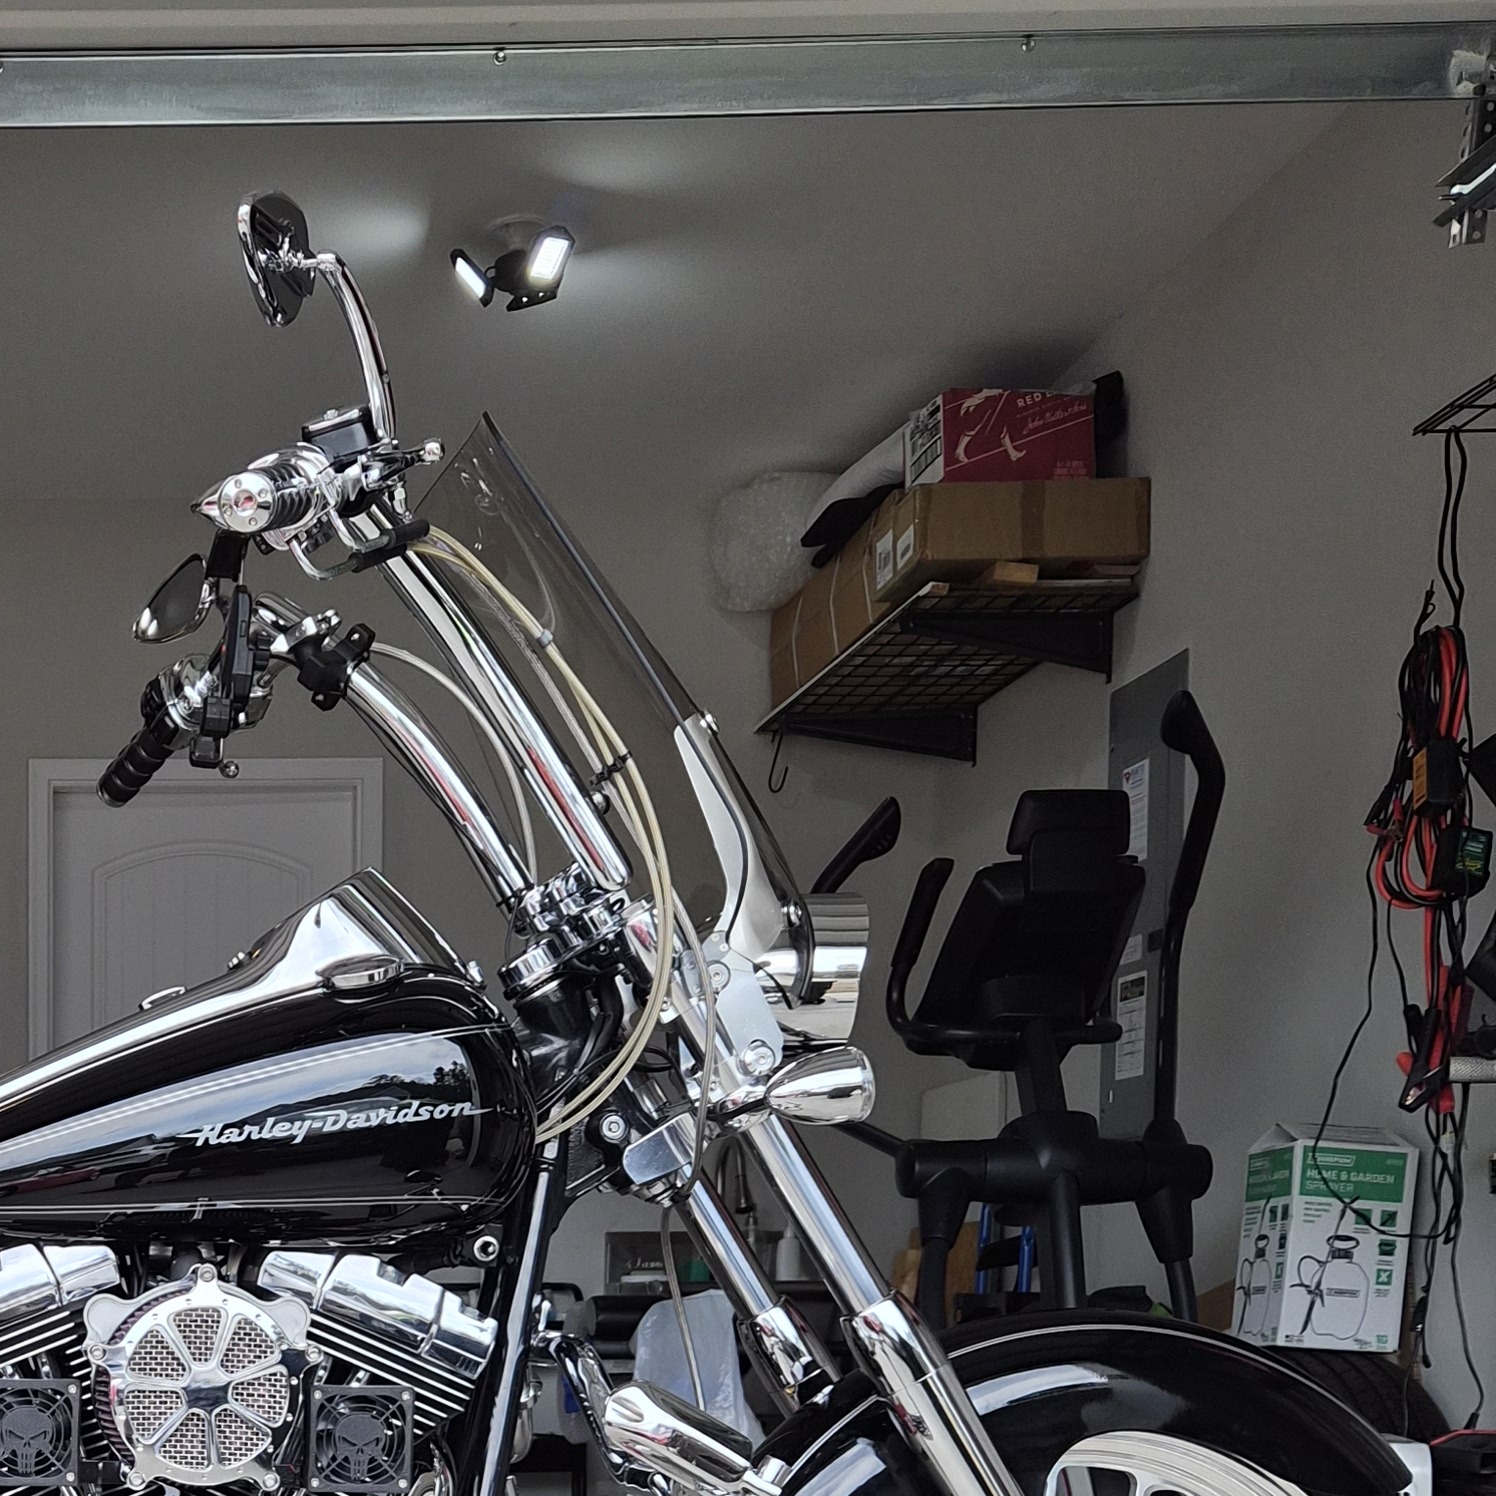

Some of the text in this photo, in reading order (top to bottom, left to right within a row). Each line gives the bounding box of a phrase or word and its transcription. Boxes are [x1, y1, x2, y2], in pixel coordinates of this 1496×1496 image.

[1017, 392, 1042, 408] RED
[176, 1100, 494, 1146] Harley-Davidson
[1349, 1172, 1395, 1185] GARDEN
[1305, 1180, 1354, 1193] SPRAYER
